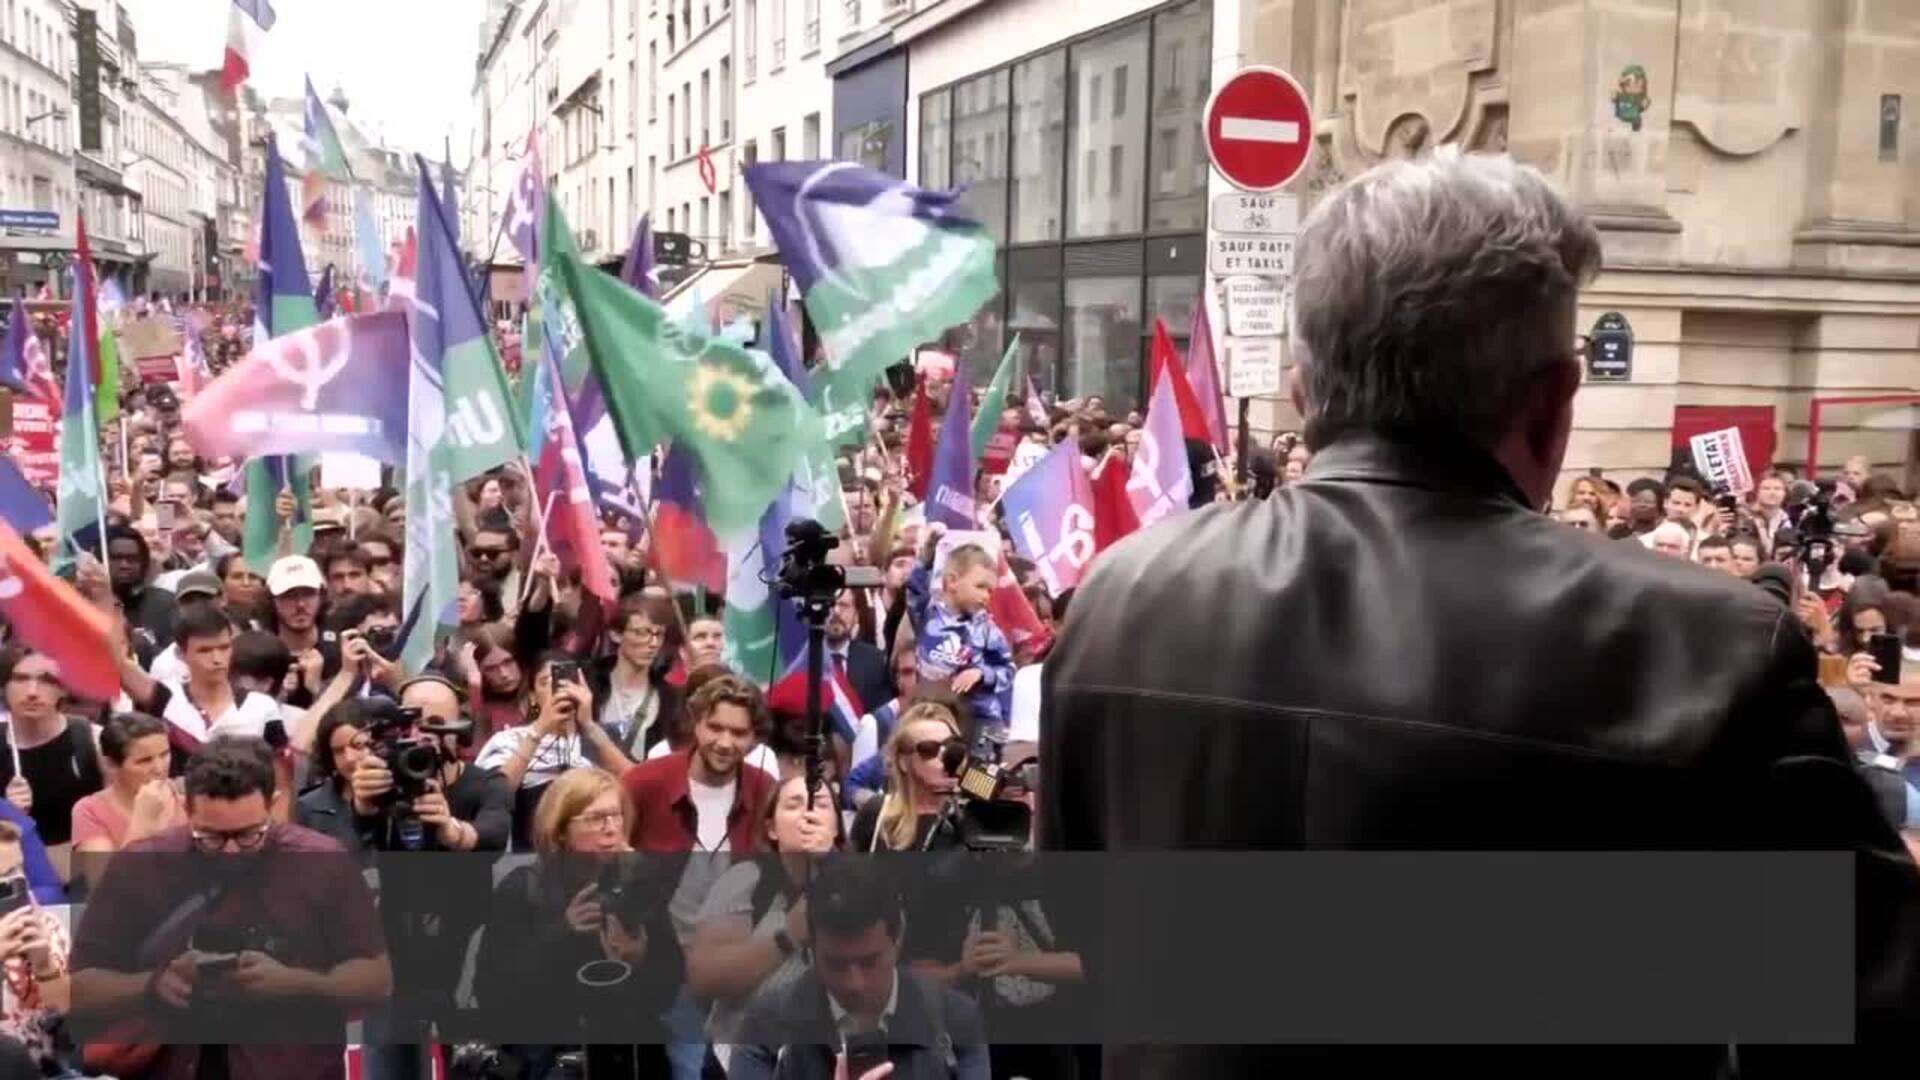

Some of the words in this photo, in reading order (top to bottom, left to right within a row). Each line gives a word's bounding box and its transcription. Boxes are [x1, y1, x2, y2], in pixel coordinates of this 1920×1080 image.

[1240, 198, 1275, 209] SAUF
[1219, 241, 1253, 253] SAUF
[1259, 241, 1292, 253] RATP
[1226, 257, 1241, 269] ET
[1248, 257, 1284, 270] TAXIS
